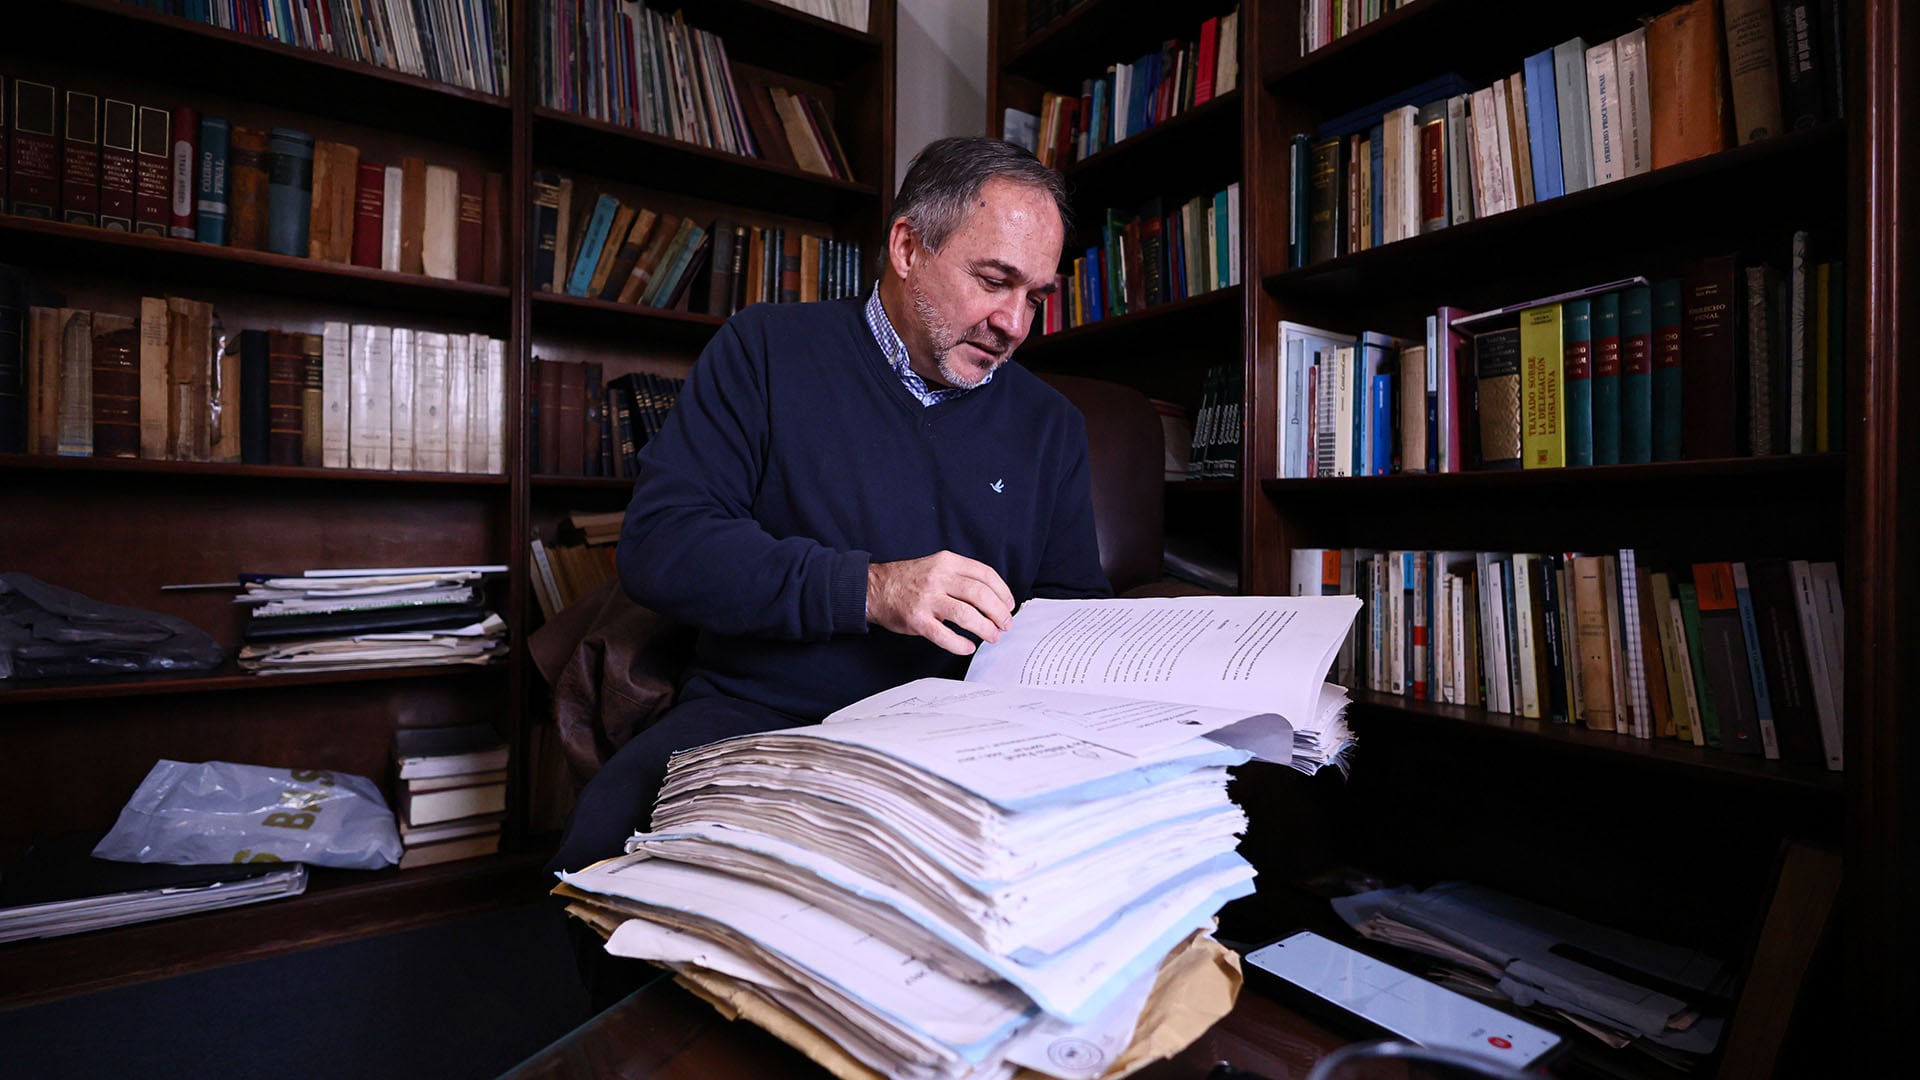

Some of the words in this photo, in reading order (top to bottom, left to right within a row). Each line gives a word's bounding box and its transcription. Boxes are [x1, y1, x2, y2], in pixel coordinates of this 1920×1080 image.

[1600, 96, 1609, 130] PROCESAL
[1602, 130, 1611, 163] DERECHO
[213, 159, 225, 195] PENAL
[1527, 356, 1536, 389] SOBRE
[1536, 357, 1546, 420] DELEGACIÓN
[1527, 391, 1536, 436] TRATADO
[1547, 370, 1556, 434] LEGISLATIVA
[1538, 422, 1546, 436] LA
